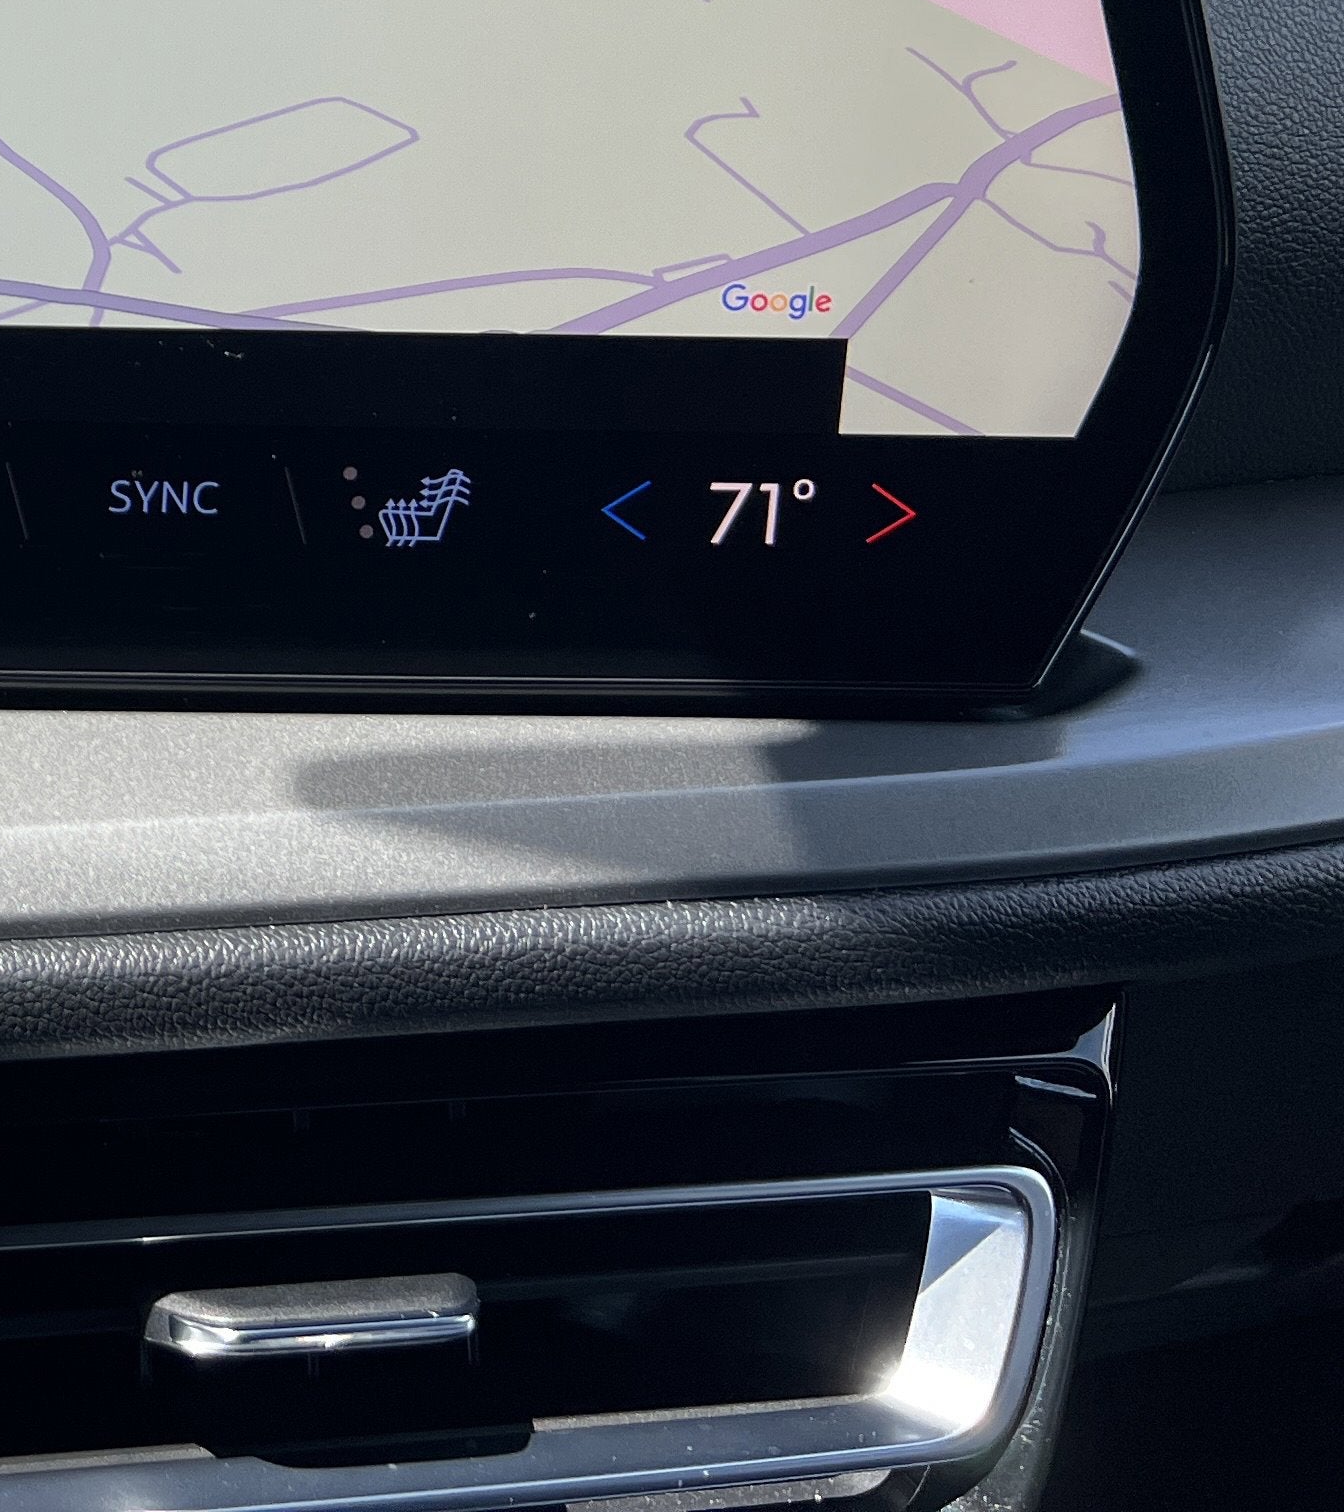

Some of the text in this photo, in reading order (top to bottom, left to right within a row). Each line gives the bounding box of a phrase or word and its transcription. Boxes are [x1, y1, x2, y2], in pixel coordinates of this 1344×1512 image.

[721, 283, 832, 319] Google
[108, 479, 219, 516] SYNC
[709, 478, 816, 546] 71°
